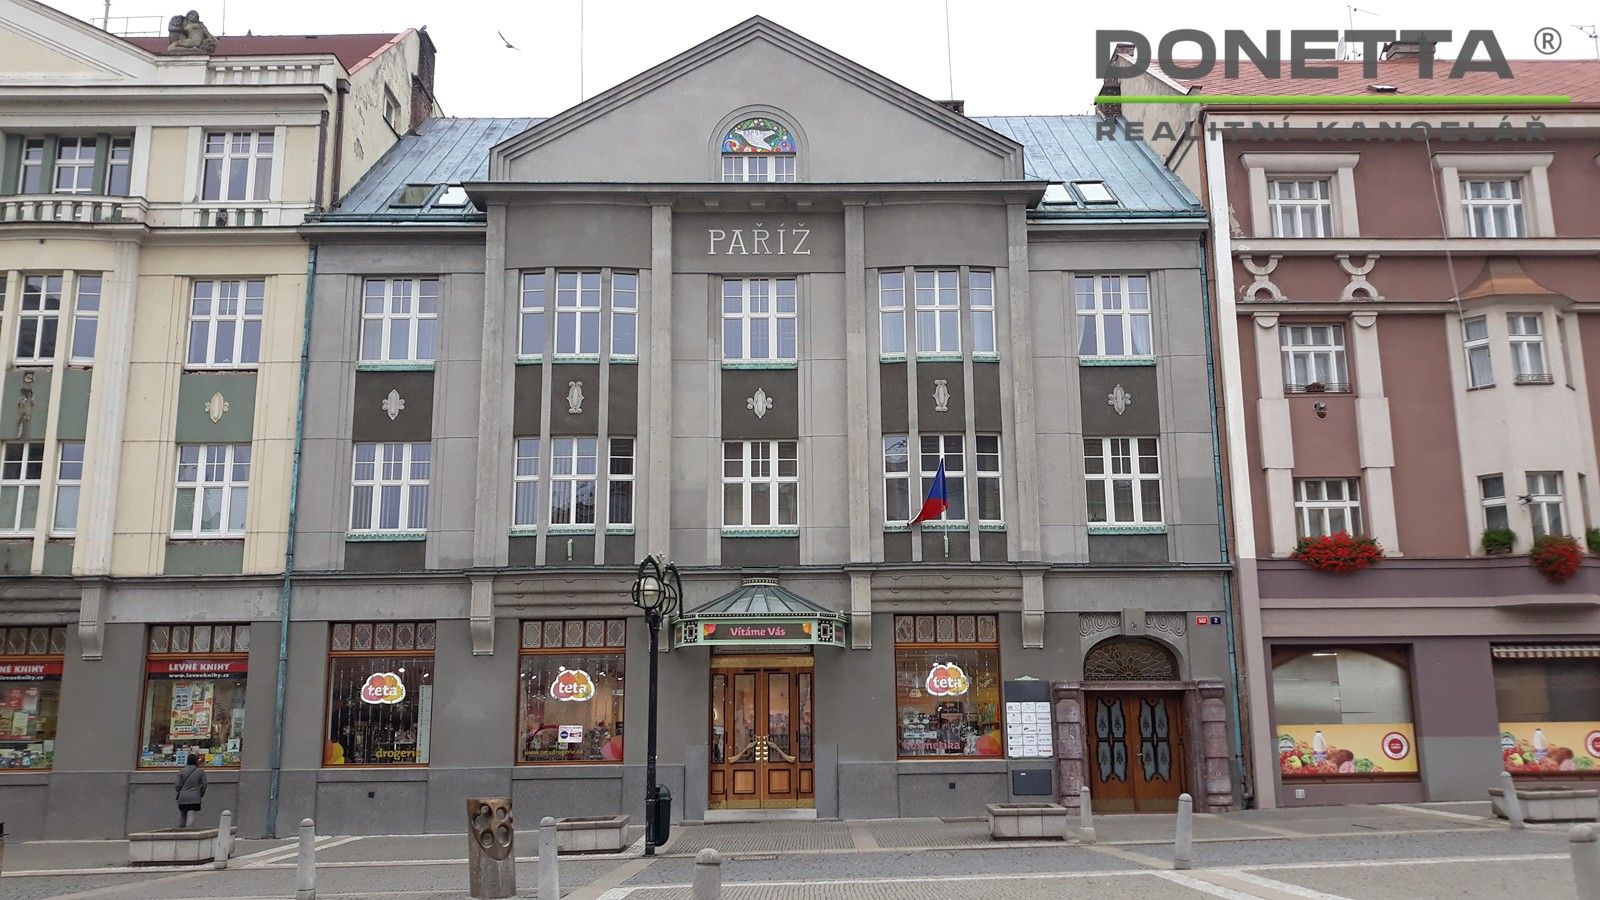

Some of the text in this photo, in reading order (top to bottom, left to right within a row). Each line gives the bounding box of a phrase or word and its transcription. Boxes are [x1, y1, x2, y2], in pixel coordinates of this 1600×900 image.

[707, 222, 811, 255] PAŘÍŽ
[729, 626, 786, 636] Vítáme Vás
[14, 664, 45, 673] KNIHY
[168, 662, 231, 671] LEVNÉ KNIHY
[558, 682, 587, 693] teta
[933, 677, 962, 688] teta
[367, 684, 398, 696] teta
